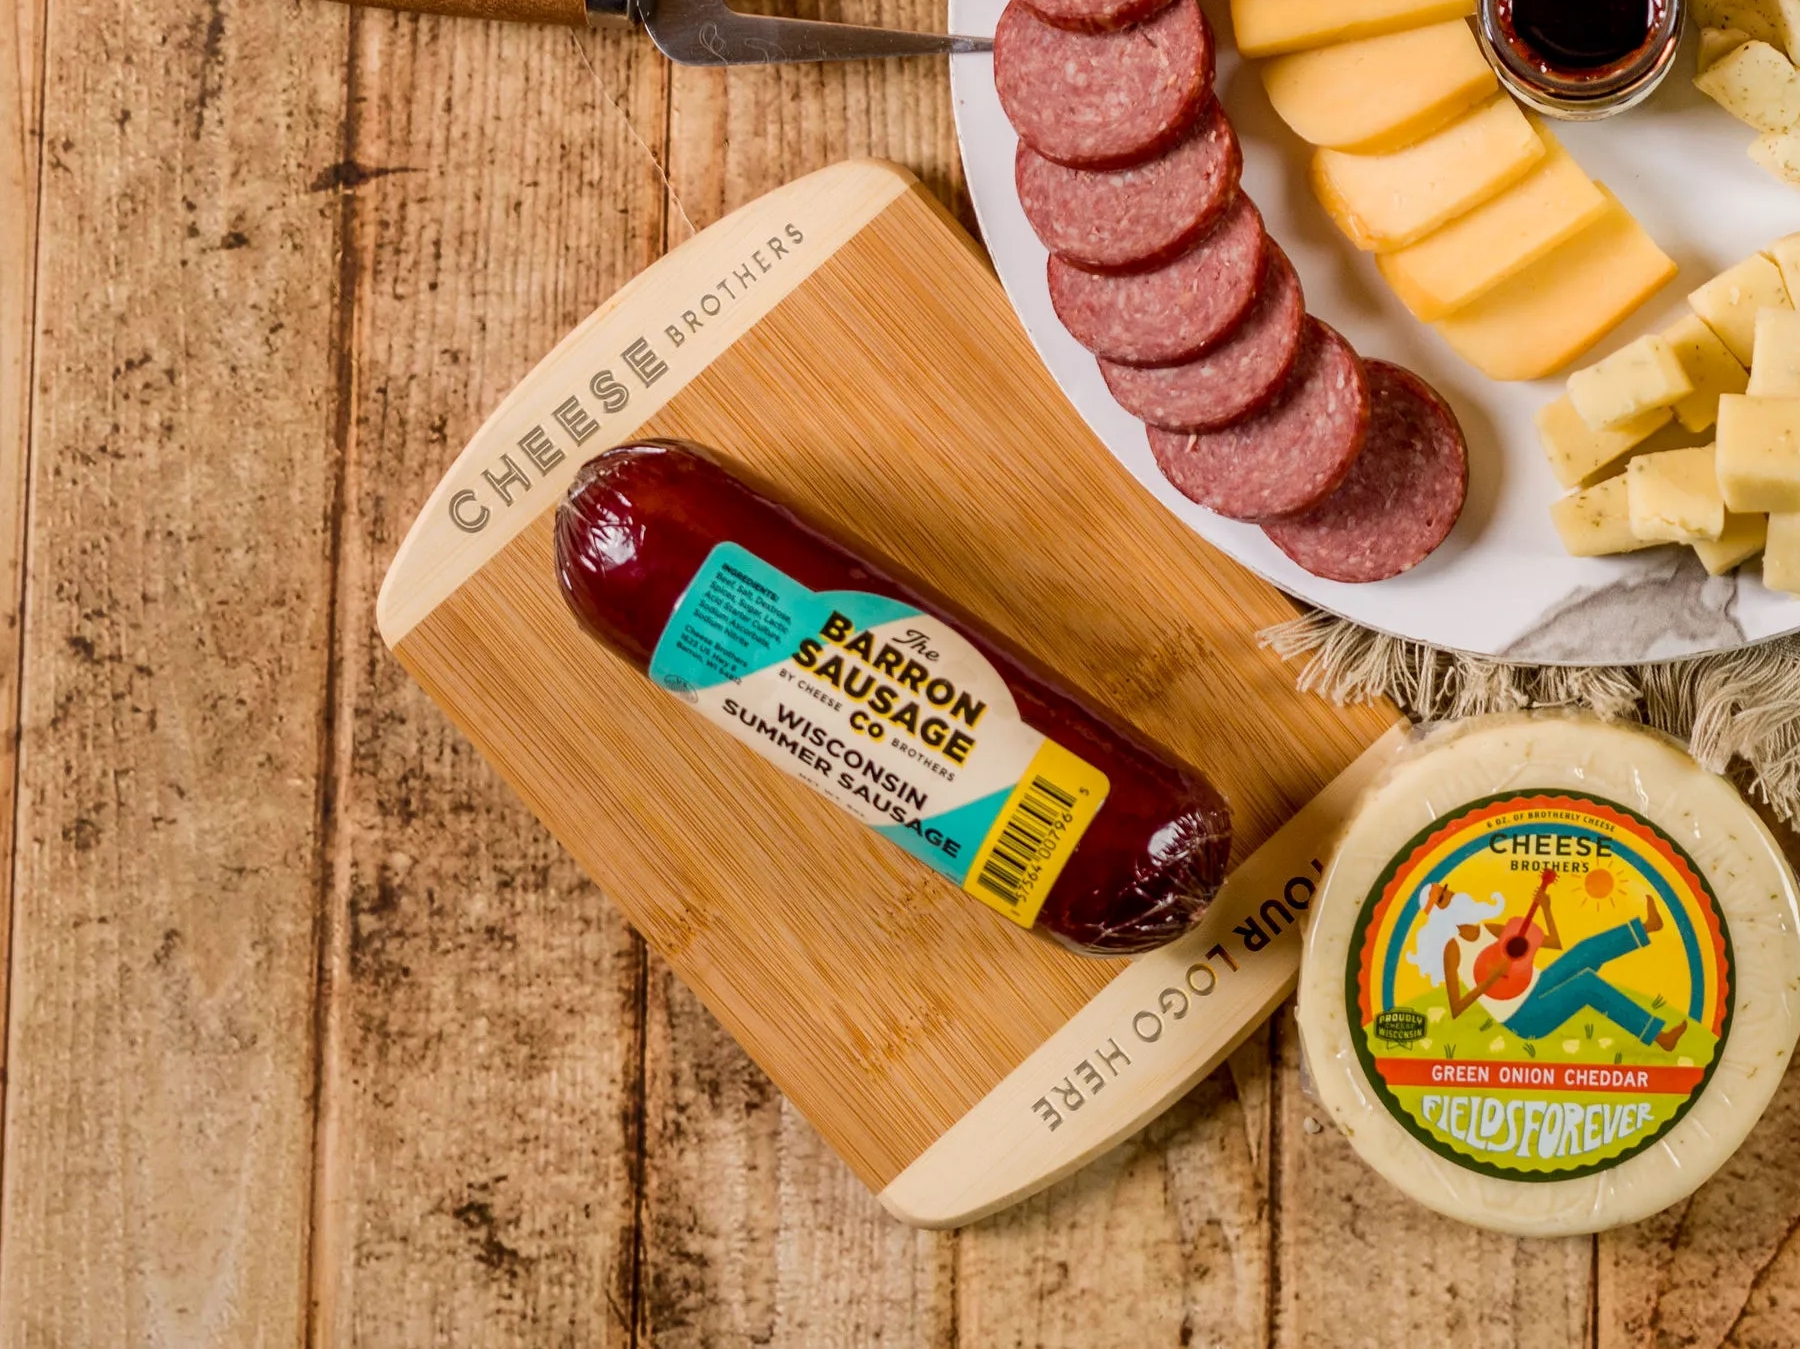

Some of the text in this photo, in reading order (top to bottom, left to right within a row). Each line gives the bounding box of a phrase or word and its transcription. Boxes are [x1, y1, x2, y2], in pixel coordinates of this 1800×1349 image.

[448, 222, 805, 534] CHEESE BROTHERS
[819, 610, 987, 729] BARRON
[892, 629, 940, 662] The
[778, 667, 956, 782] BY CHEESE BROTHERS
[792, 637, 977, 764] SAUSAGE
[722, 698, 833, 778] SUMMER
[837, 772, 962, 859] SAUSAGE
[777, 703, 929, 811] WISCONSIN
[1016, 786, 1090, 903] 57564 00796 5
[1489, 833, 1613, 858] CHEESE
[1510, 859, 1590, 874] BROTHERS
[1513, 813, 1525, 821] OF
[1527, 810, 1581, 821] BROTHERLY
[1583, 815, 1616, 833] CHEESE
[1132, 943, 1241, 1043] LOGO
[1379, 1013, 1423, 1026] PROUDLY
[1030, 1038, 1132, 1133] HERE
[1431, 1064, 1649, 1088] GREEN ONION CHEDDAR
